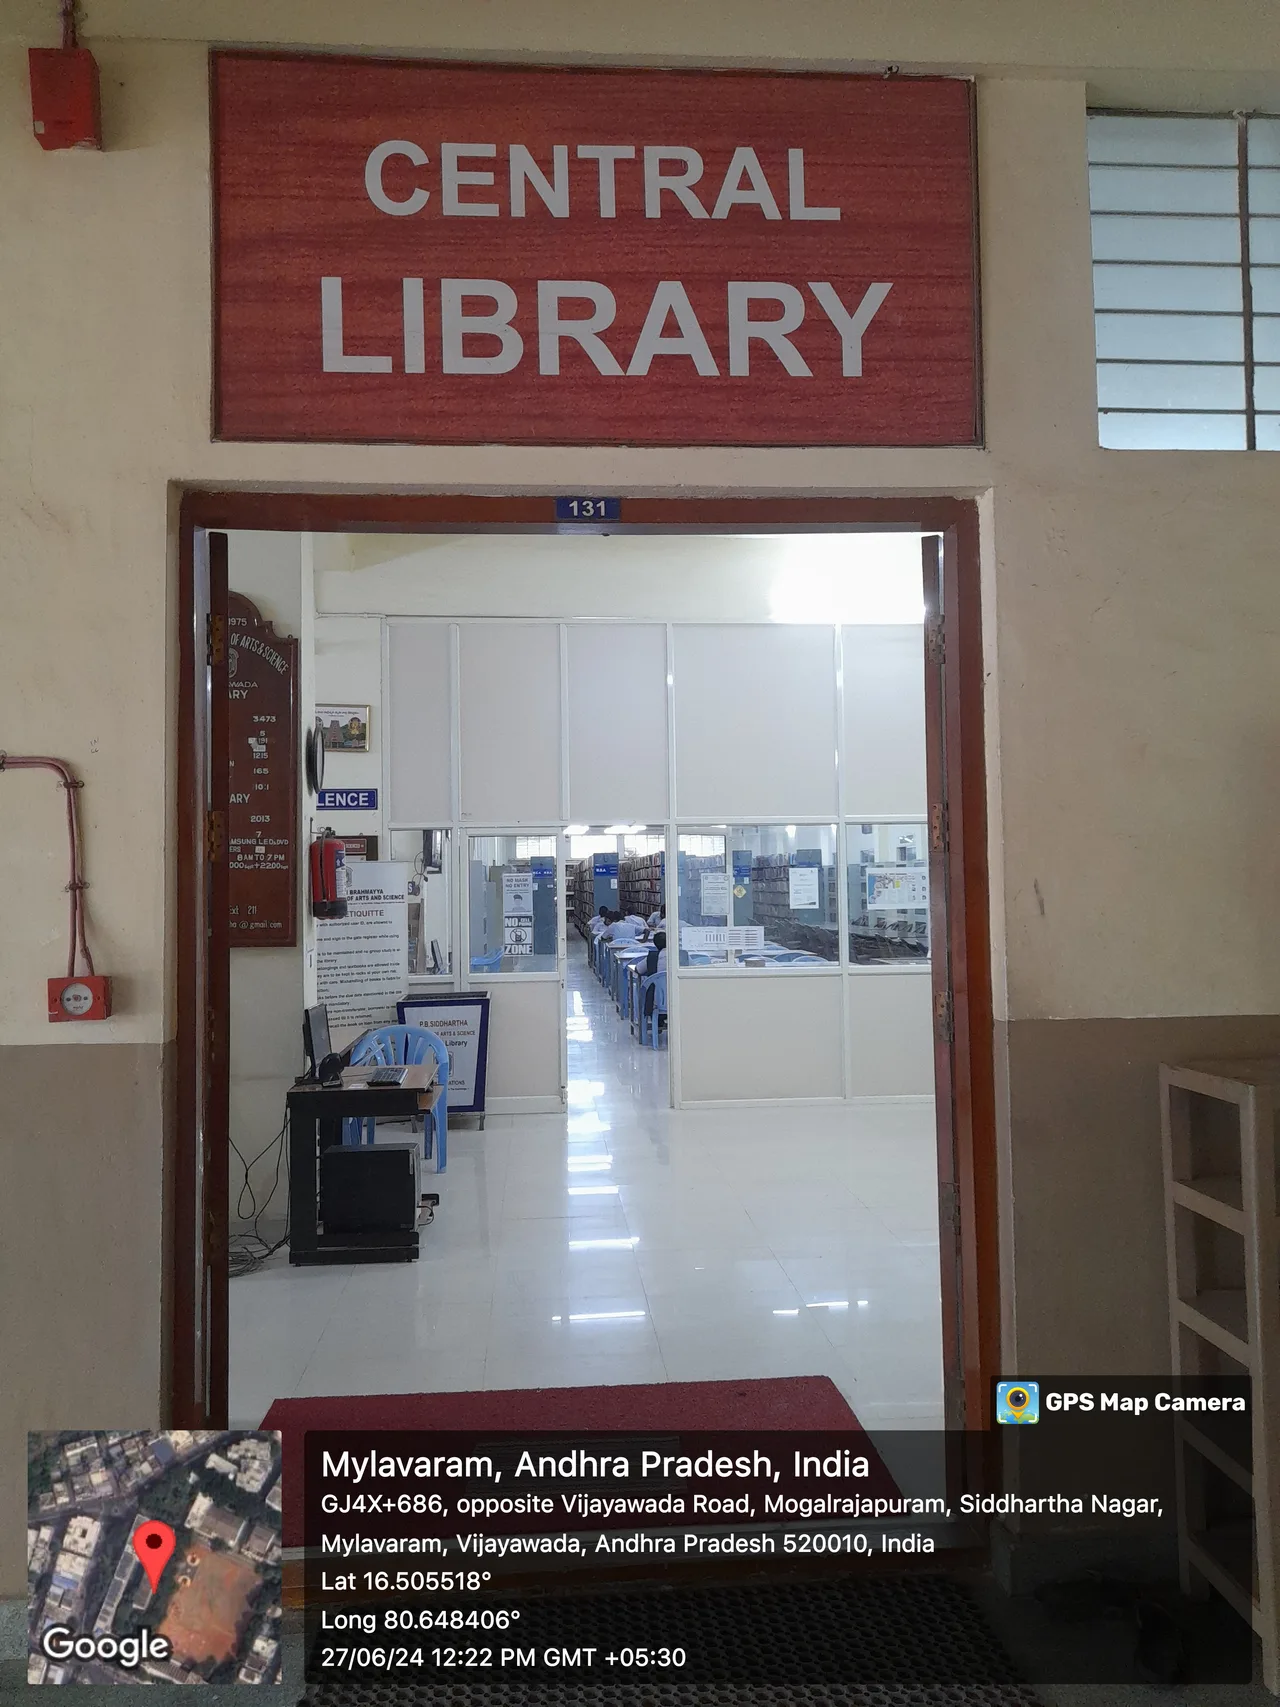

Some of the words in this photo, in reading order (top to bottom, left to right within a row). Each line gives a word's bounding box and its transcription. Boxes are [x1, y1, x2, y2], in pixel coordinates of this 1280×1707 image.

[365, 140, 841, 221] CENTRAL
[321, 277, 893, 377] LIBRARY
[569, 501, 605, 516] 131
[230, 633, 239, 645] OF
[316, 792, 369, 807] LENCE
[504, 918, 518, 927] NO
[504, 944, 532, 954] ZONE
